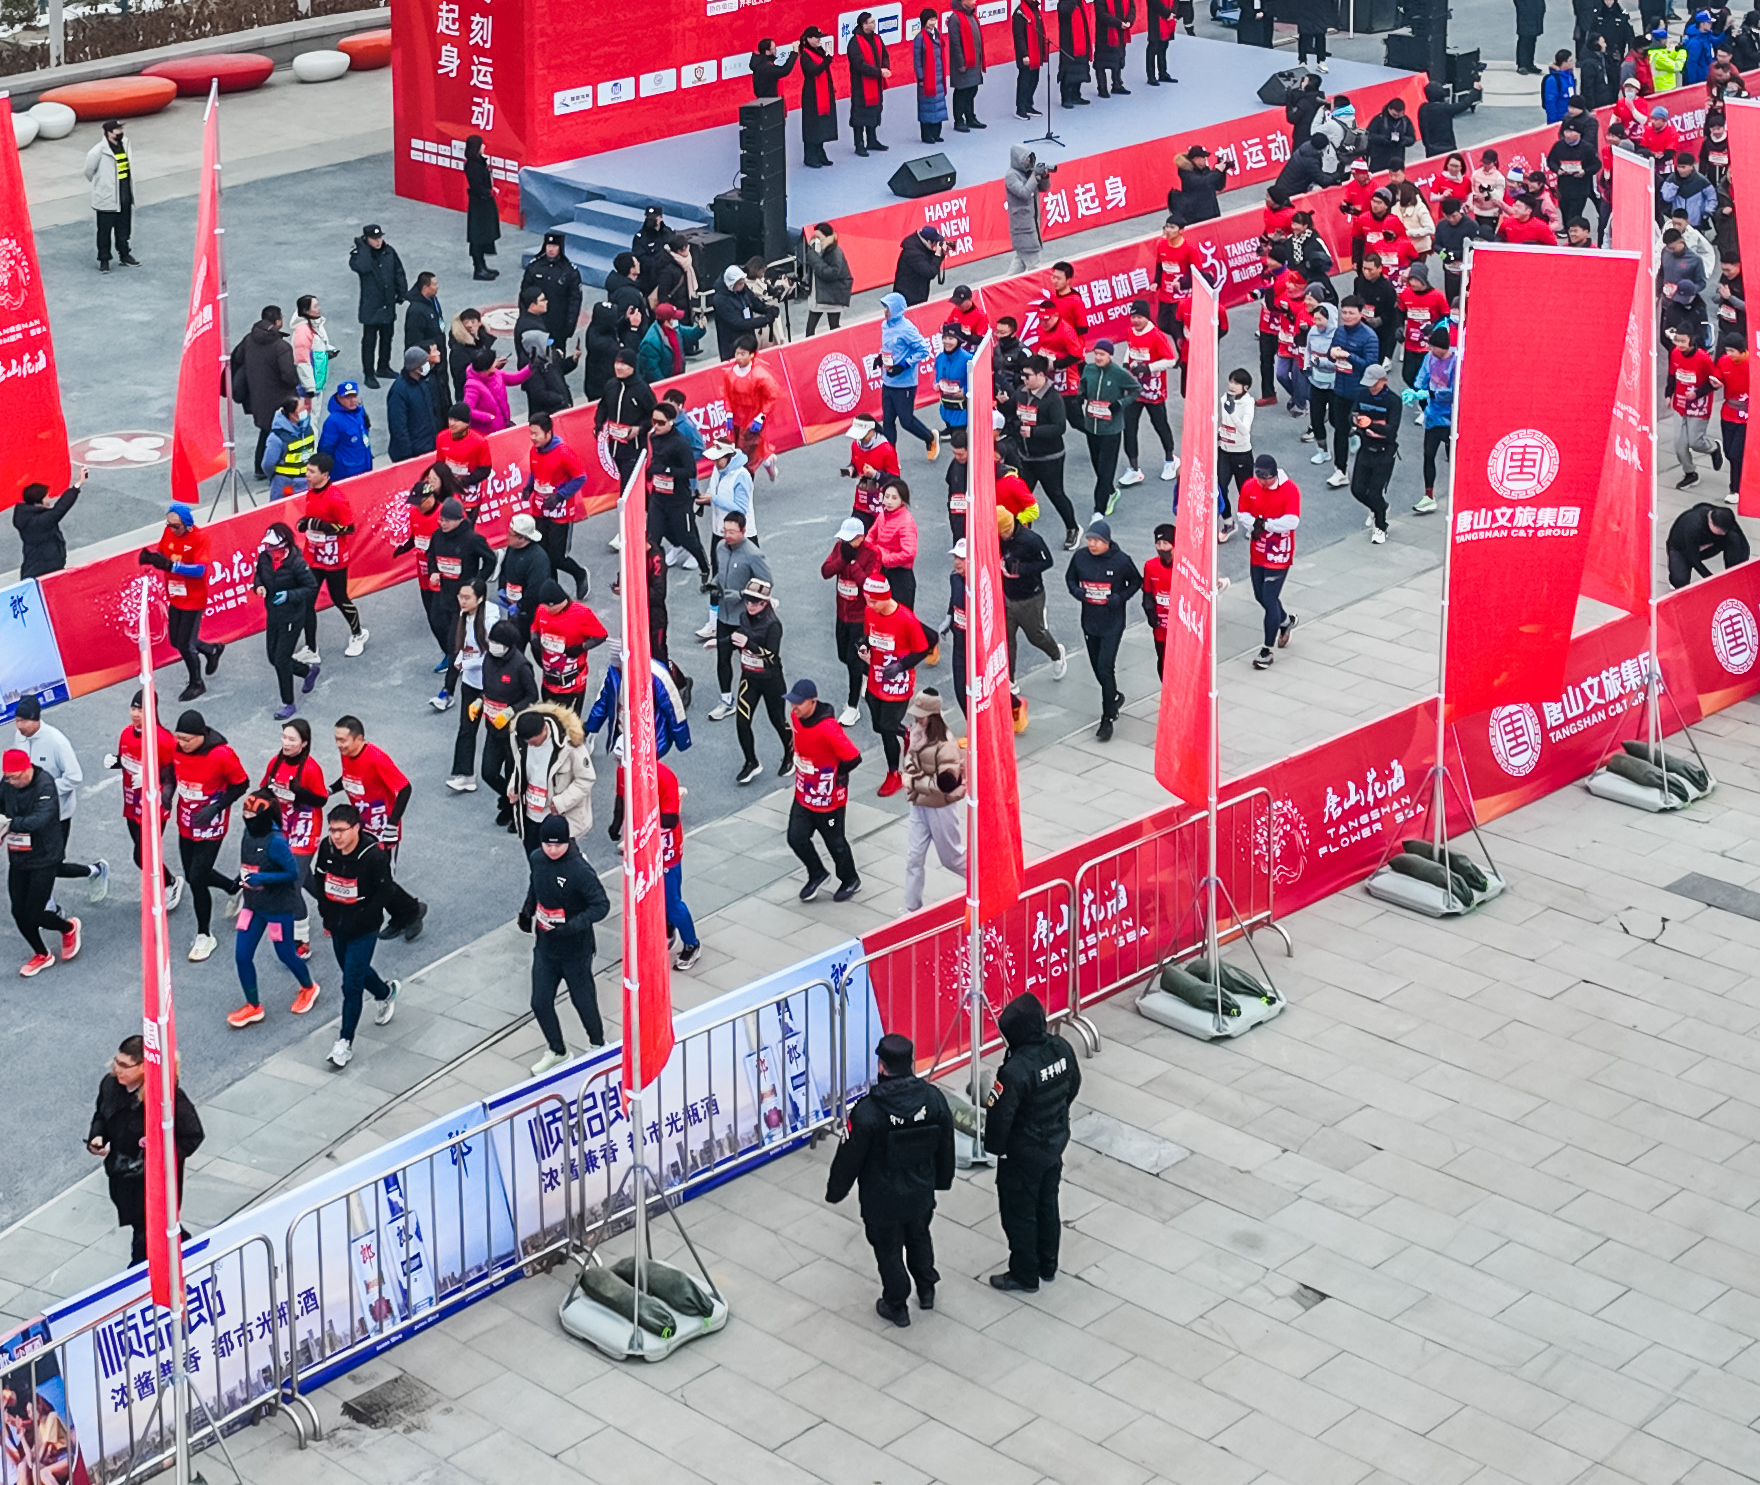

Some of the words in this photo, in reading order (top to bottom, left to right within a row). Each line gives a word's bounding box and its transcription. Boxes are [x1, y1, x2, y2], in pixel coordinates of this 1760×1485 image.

[923, 196, 968, 225] HAPPY
[1455, 506, 1582, 535] 唐山文旅集团
[1455, 529, 1509, 544] TANGSHAN
[1511, 528, 1535, 539] C&T
[1537, 527, 1579, 539] GROUP
[1548, 711, 1606, 745] TANGSHAN
[1323, 758, 1406, 825] 唐山花海
[1326, 795, 1411, 840] TANGSHAN
[1318, 822, 1383, 859] FLOWER
[1114, 925, 1150, 949] SEA
